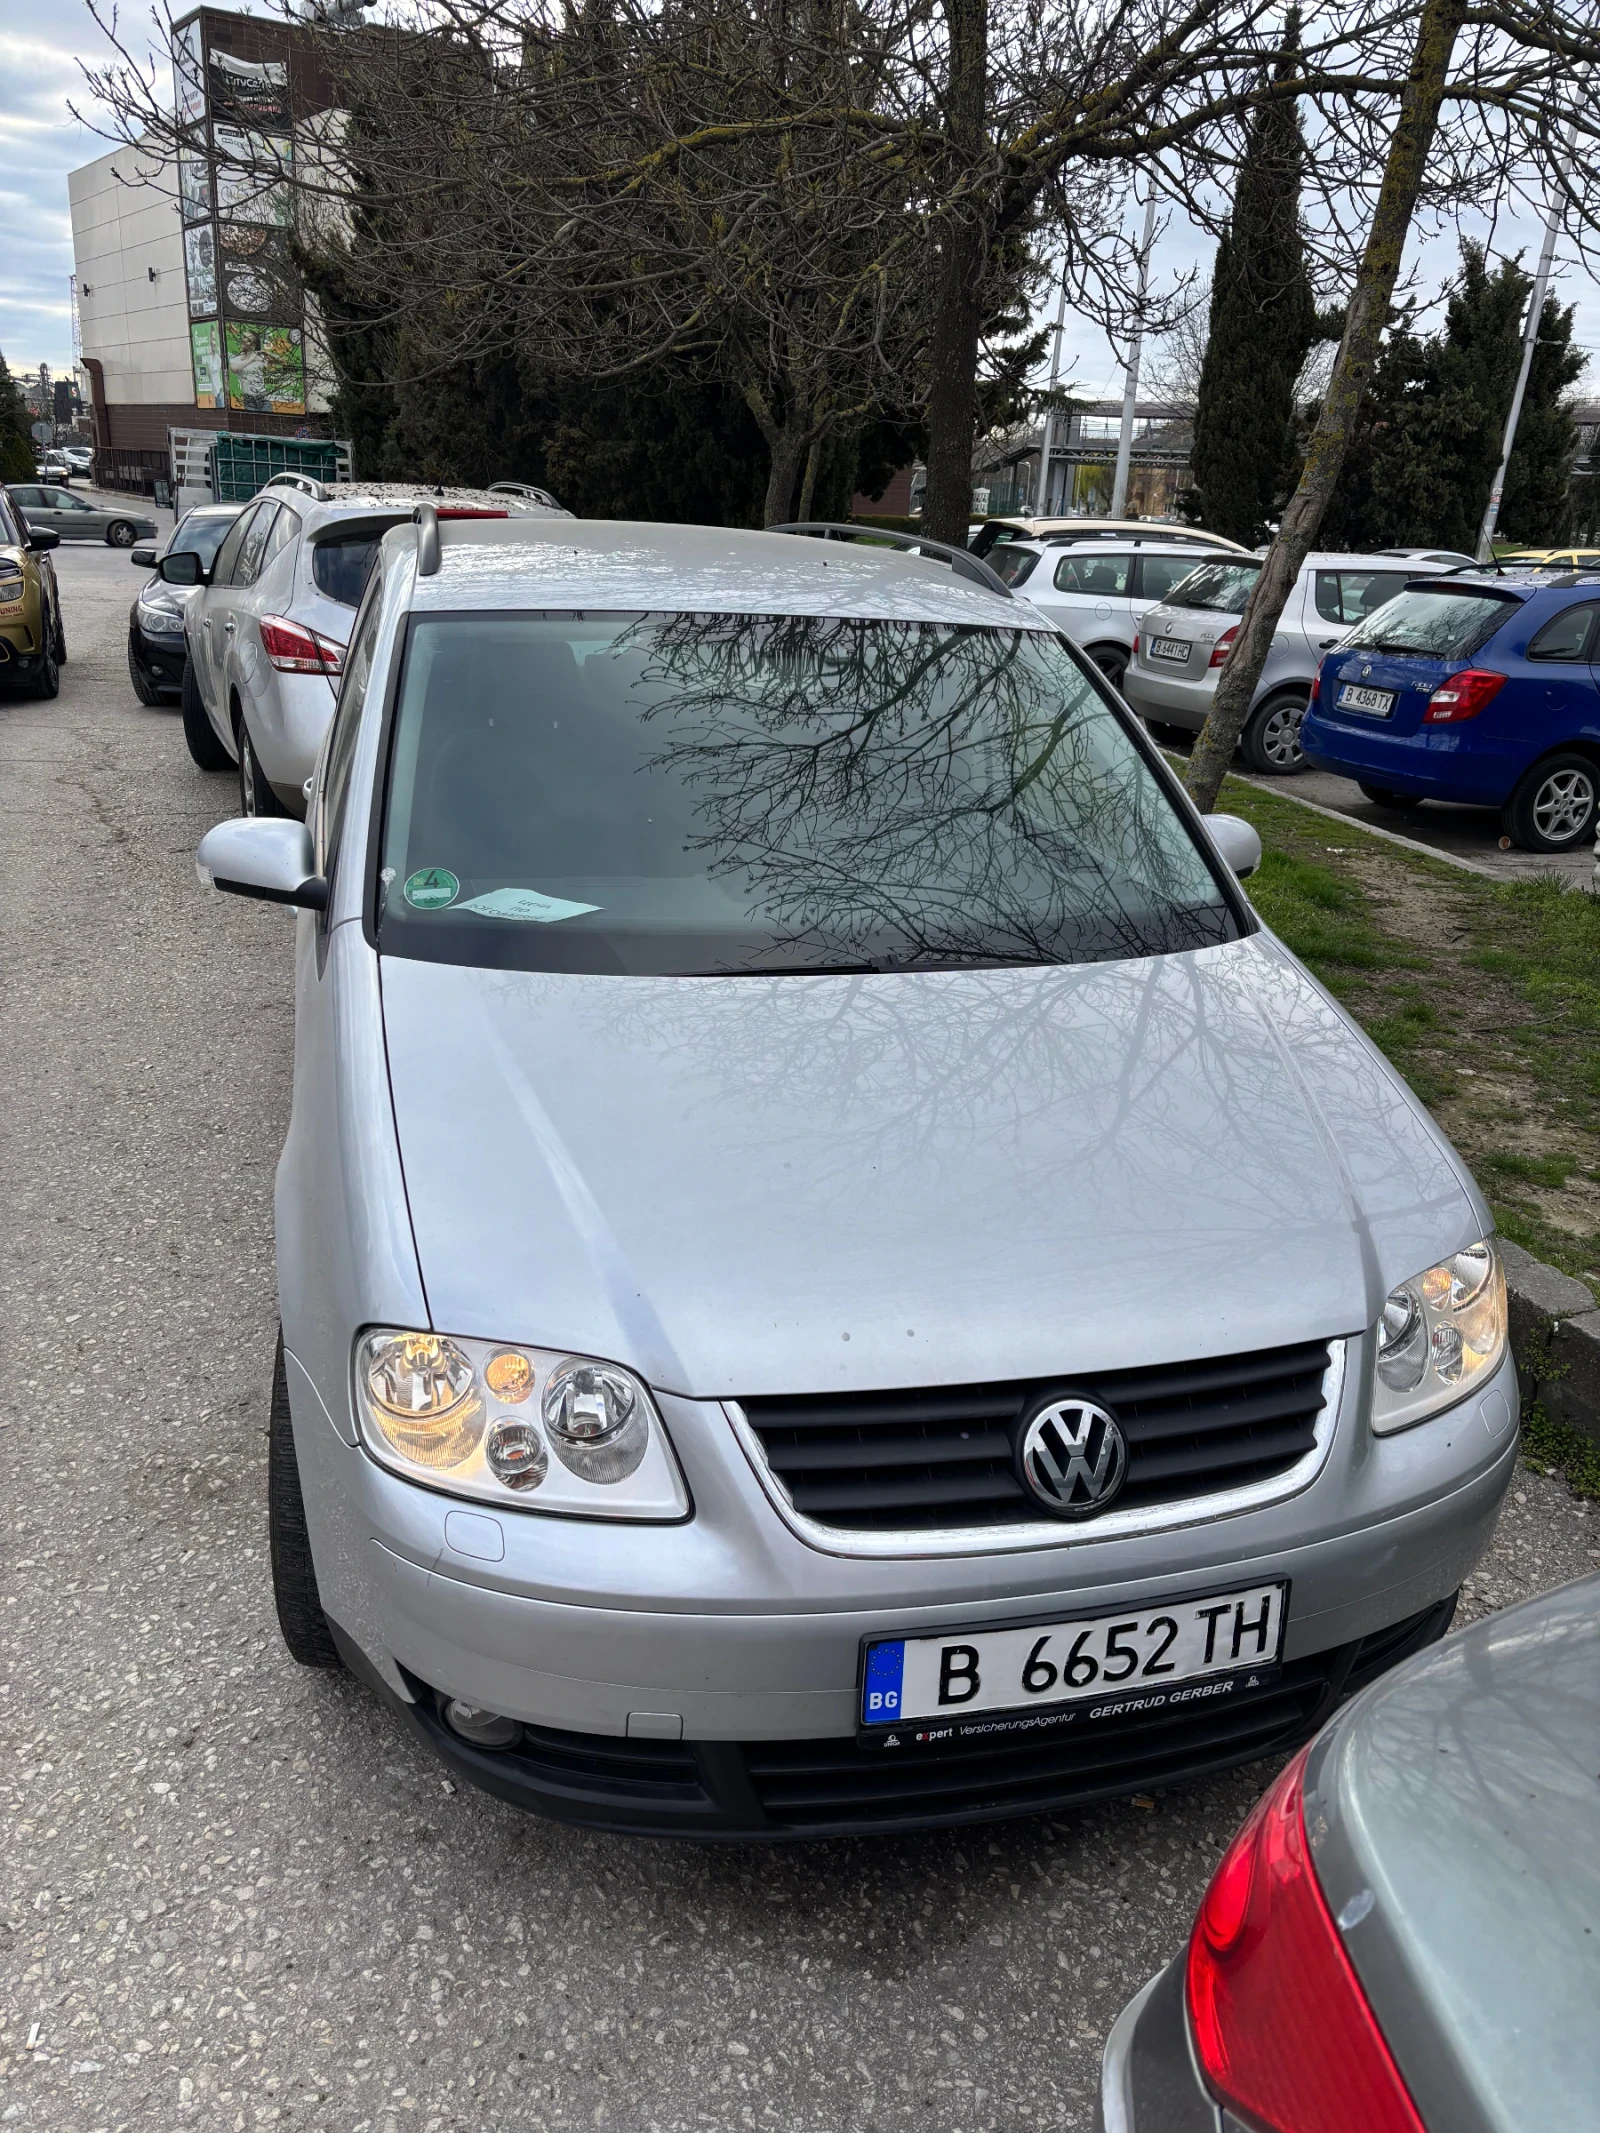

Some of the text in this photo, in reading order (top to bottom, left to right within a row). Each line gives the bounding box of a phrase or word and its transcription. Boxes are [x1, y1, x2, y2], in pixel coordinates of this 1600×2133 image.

[1163, 642, 1178, 656] 6441
[1177, 645, 1188, 658] HC
[1346, 687, 1391, 710] B 4368 TX
[423, 870, 440, 888] 4
[938, 1594, 1271, 1706] B 6652 TH
[869, 1690, 898, 1710] BG
[916, 1727, 953, 1742] expert
[959, 1712, 1077, 1736] VersicherungsAgentur
[1089, 1695, 1165, 1719] GERTRUD
[1169, 1681, 1234, 1703] GERBER
